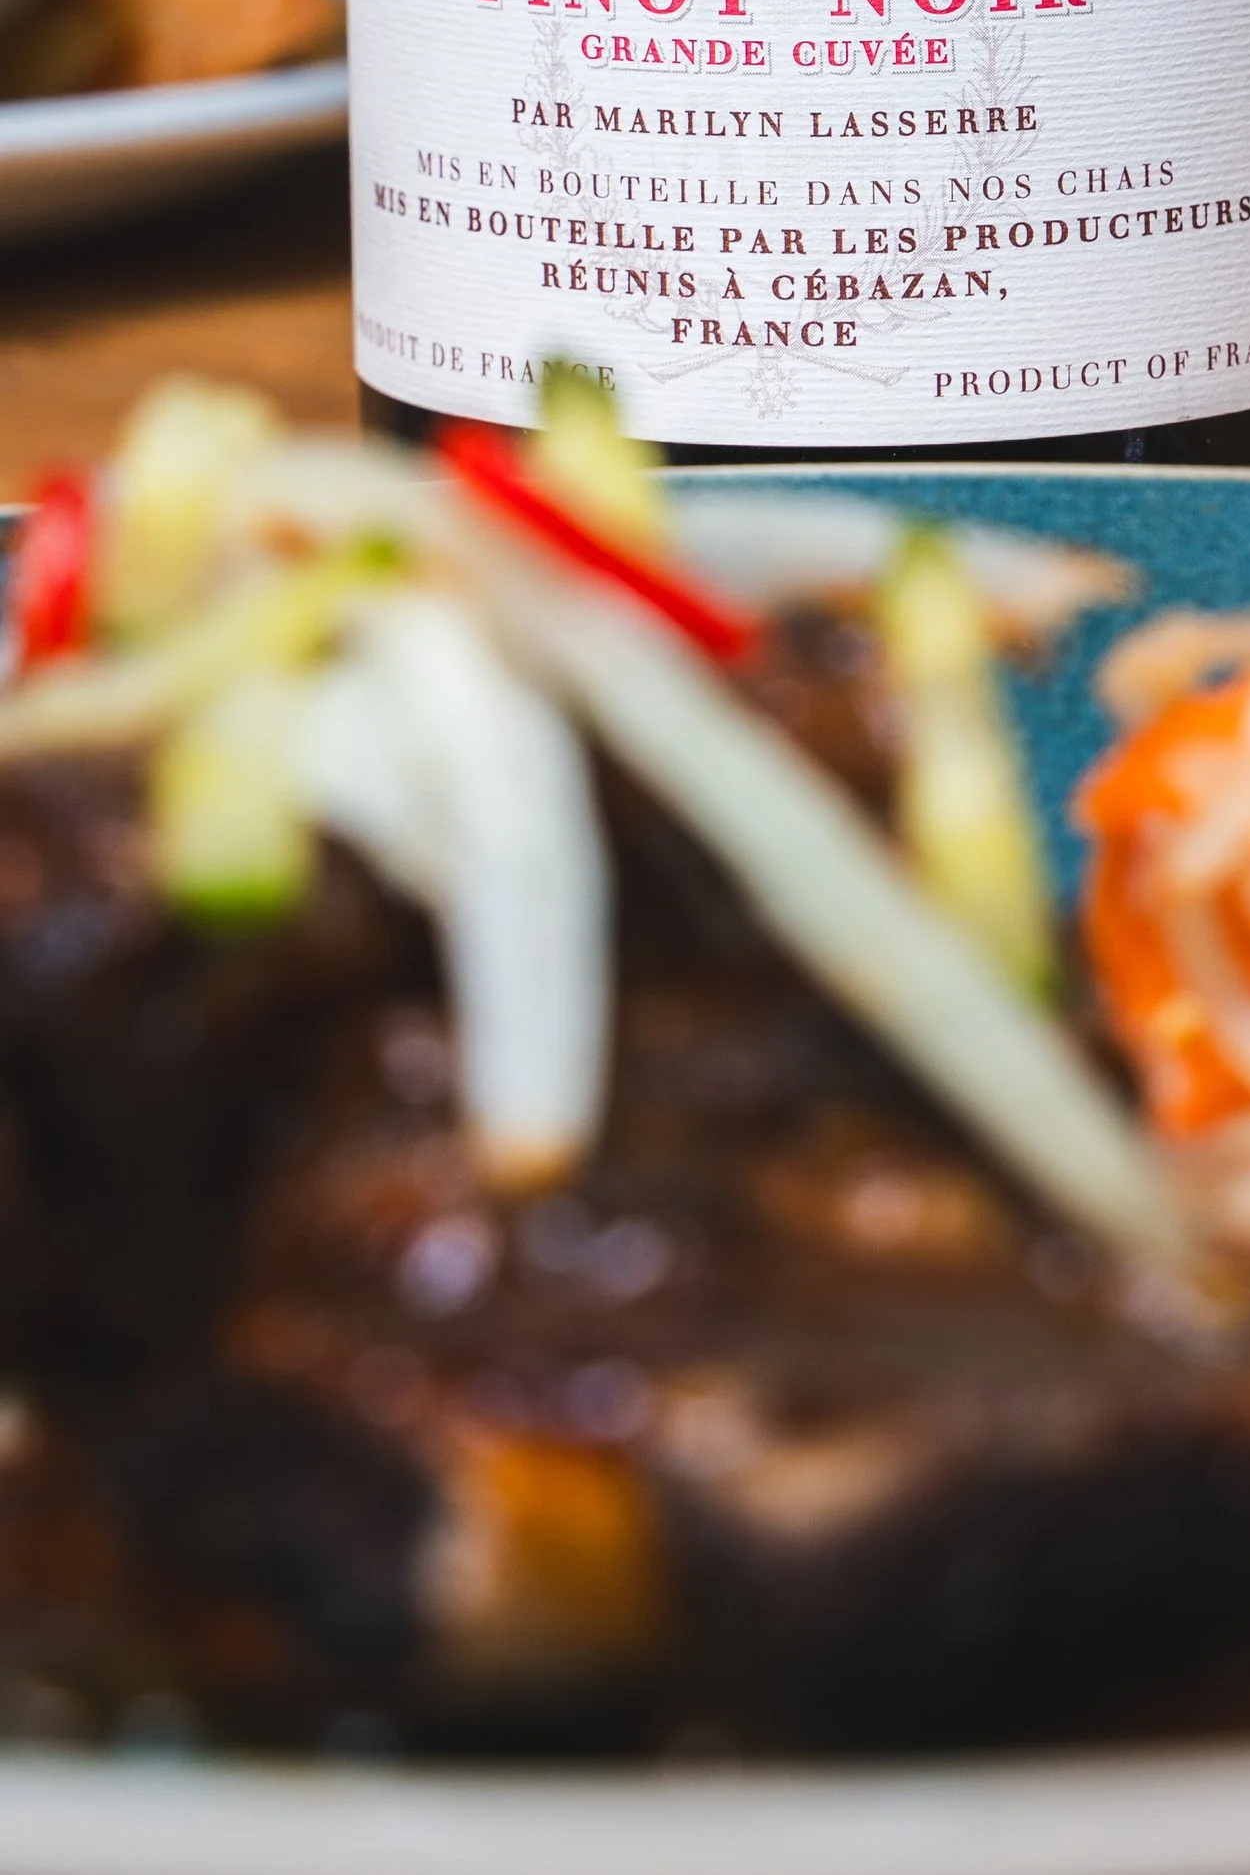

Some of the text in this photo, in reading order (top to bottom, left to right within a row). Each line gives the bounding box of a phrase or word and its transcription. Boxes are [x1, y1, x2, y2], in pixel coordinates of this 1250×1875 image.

[579, 31, 958, 75] GRANDE CUVÉE
[510, 97, 1040, 139] PAR MARILYN LASSERRE
[416, 150, 1177, 208] MIS EN BOUTEILLE DANS NOS CHAIS
[372, 182, 407, 215] MIS
[418, 195, 452, 228] EN
[466, 207, 696, 254] BOUTEILLE
[719, 225, 808, 256] PAR
[831, 226, 918, 256] LES
[539, 256, 1010, 305] RÉUNIS À CÉBAZAN,
[670, 316, 860, 349] FRANCE
[431, 342, 465, 372] DE
[934, 360, 1127, 400] PRODUCT
[1147, 351, 1192, 381] OF
